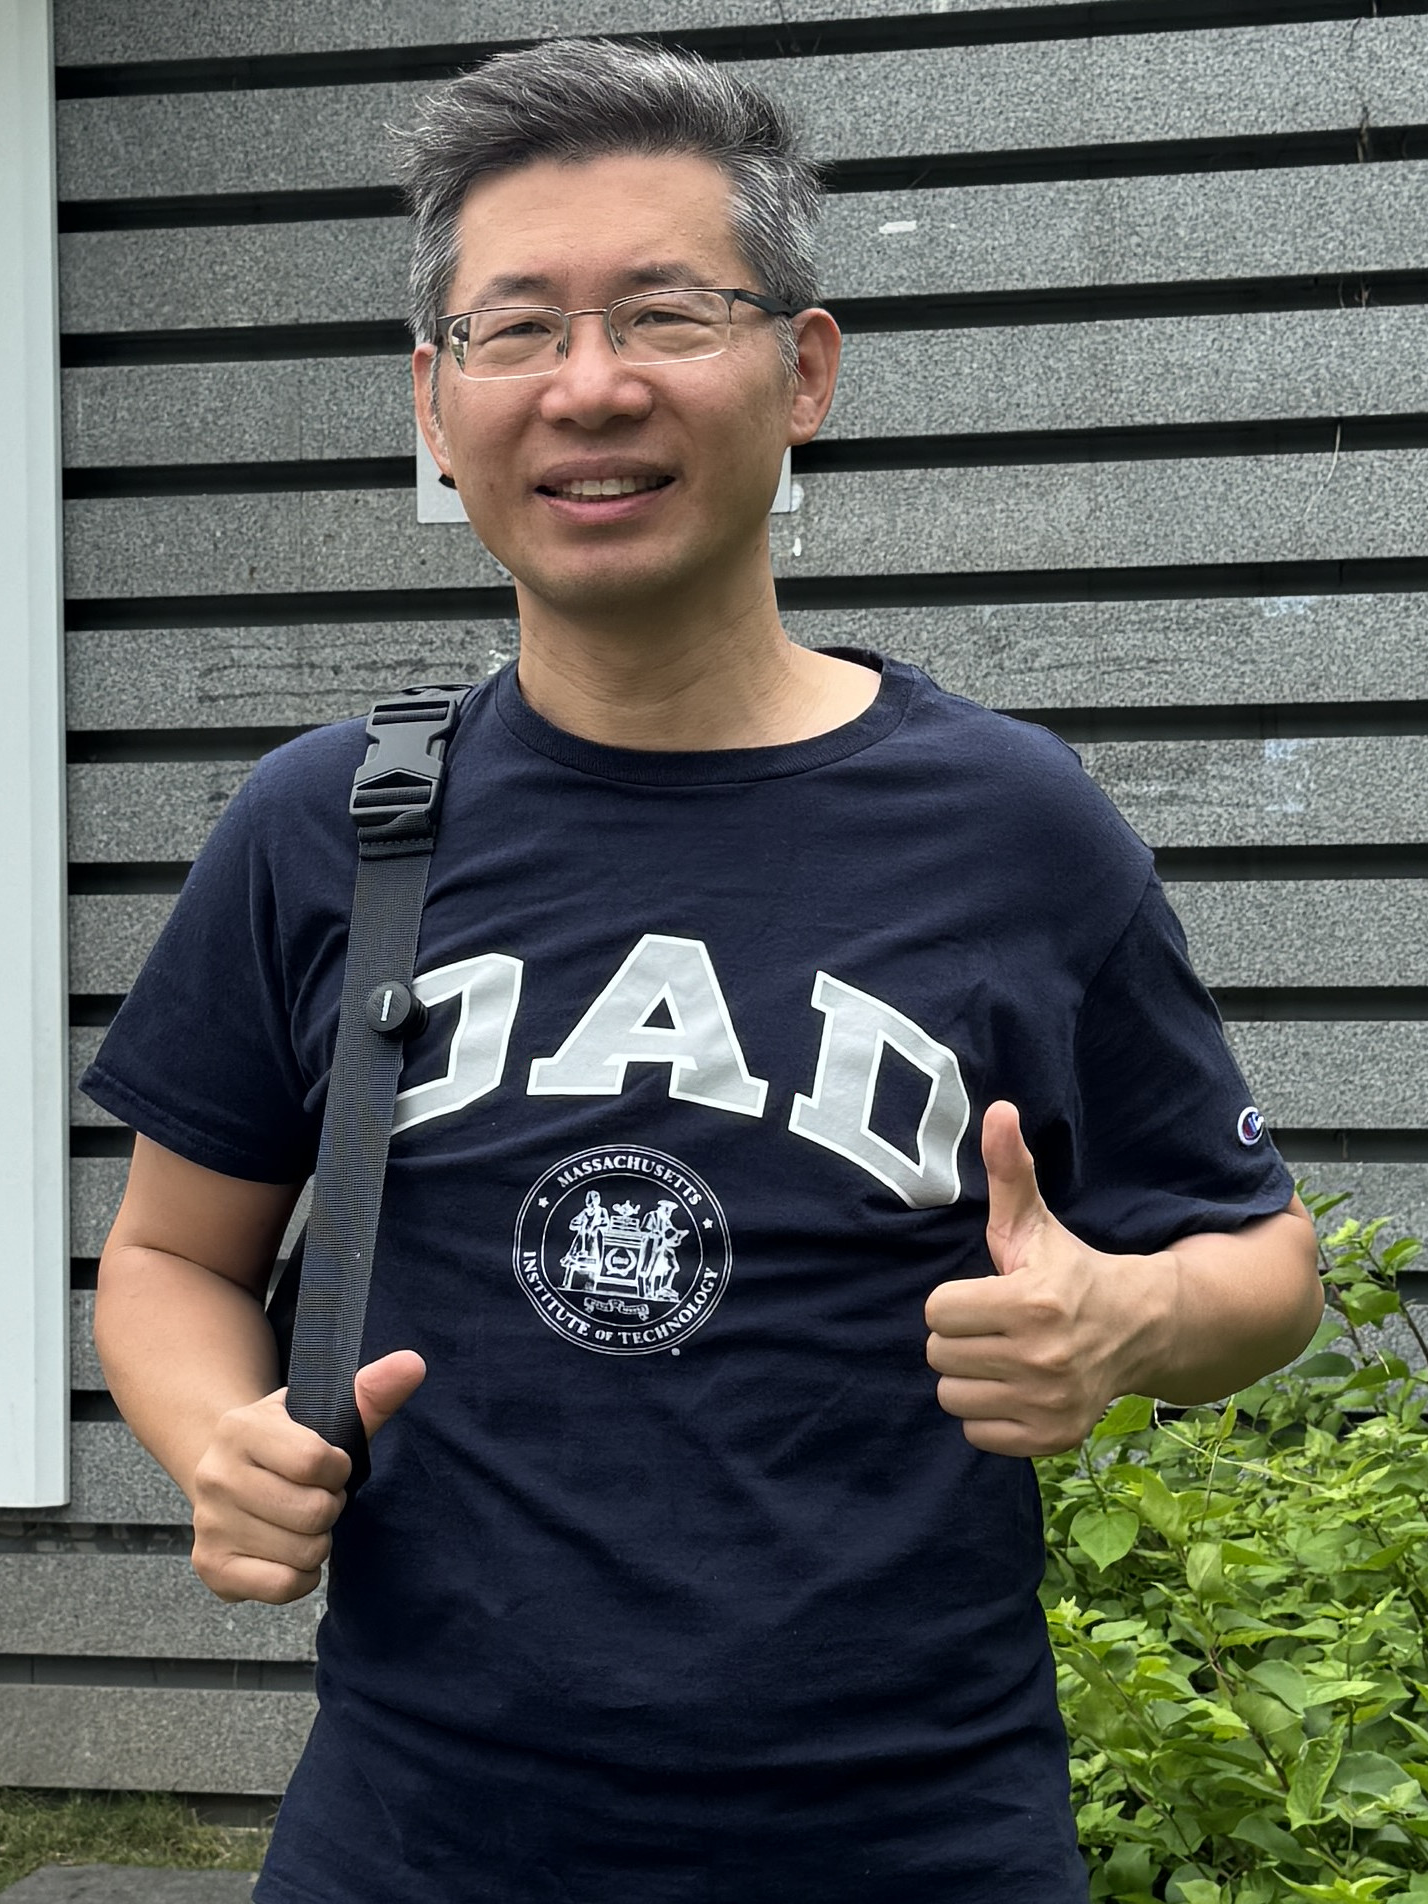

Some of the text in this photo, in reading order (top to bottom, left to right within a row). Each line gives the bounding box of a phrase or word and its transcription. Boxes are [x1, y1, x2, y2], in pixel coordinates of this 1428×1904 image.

[556, 1155, 703, 1206] MASSACHUSETTS
[523, 1250, 591, 1337] INSTITUTE
[618, 1267, 719, 1345] TECHNOLOGY
